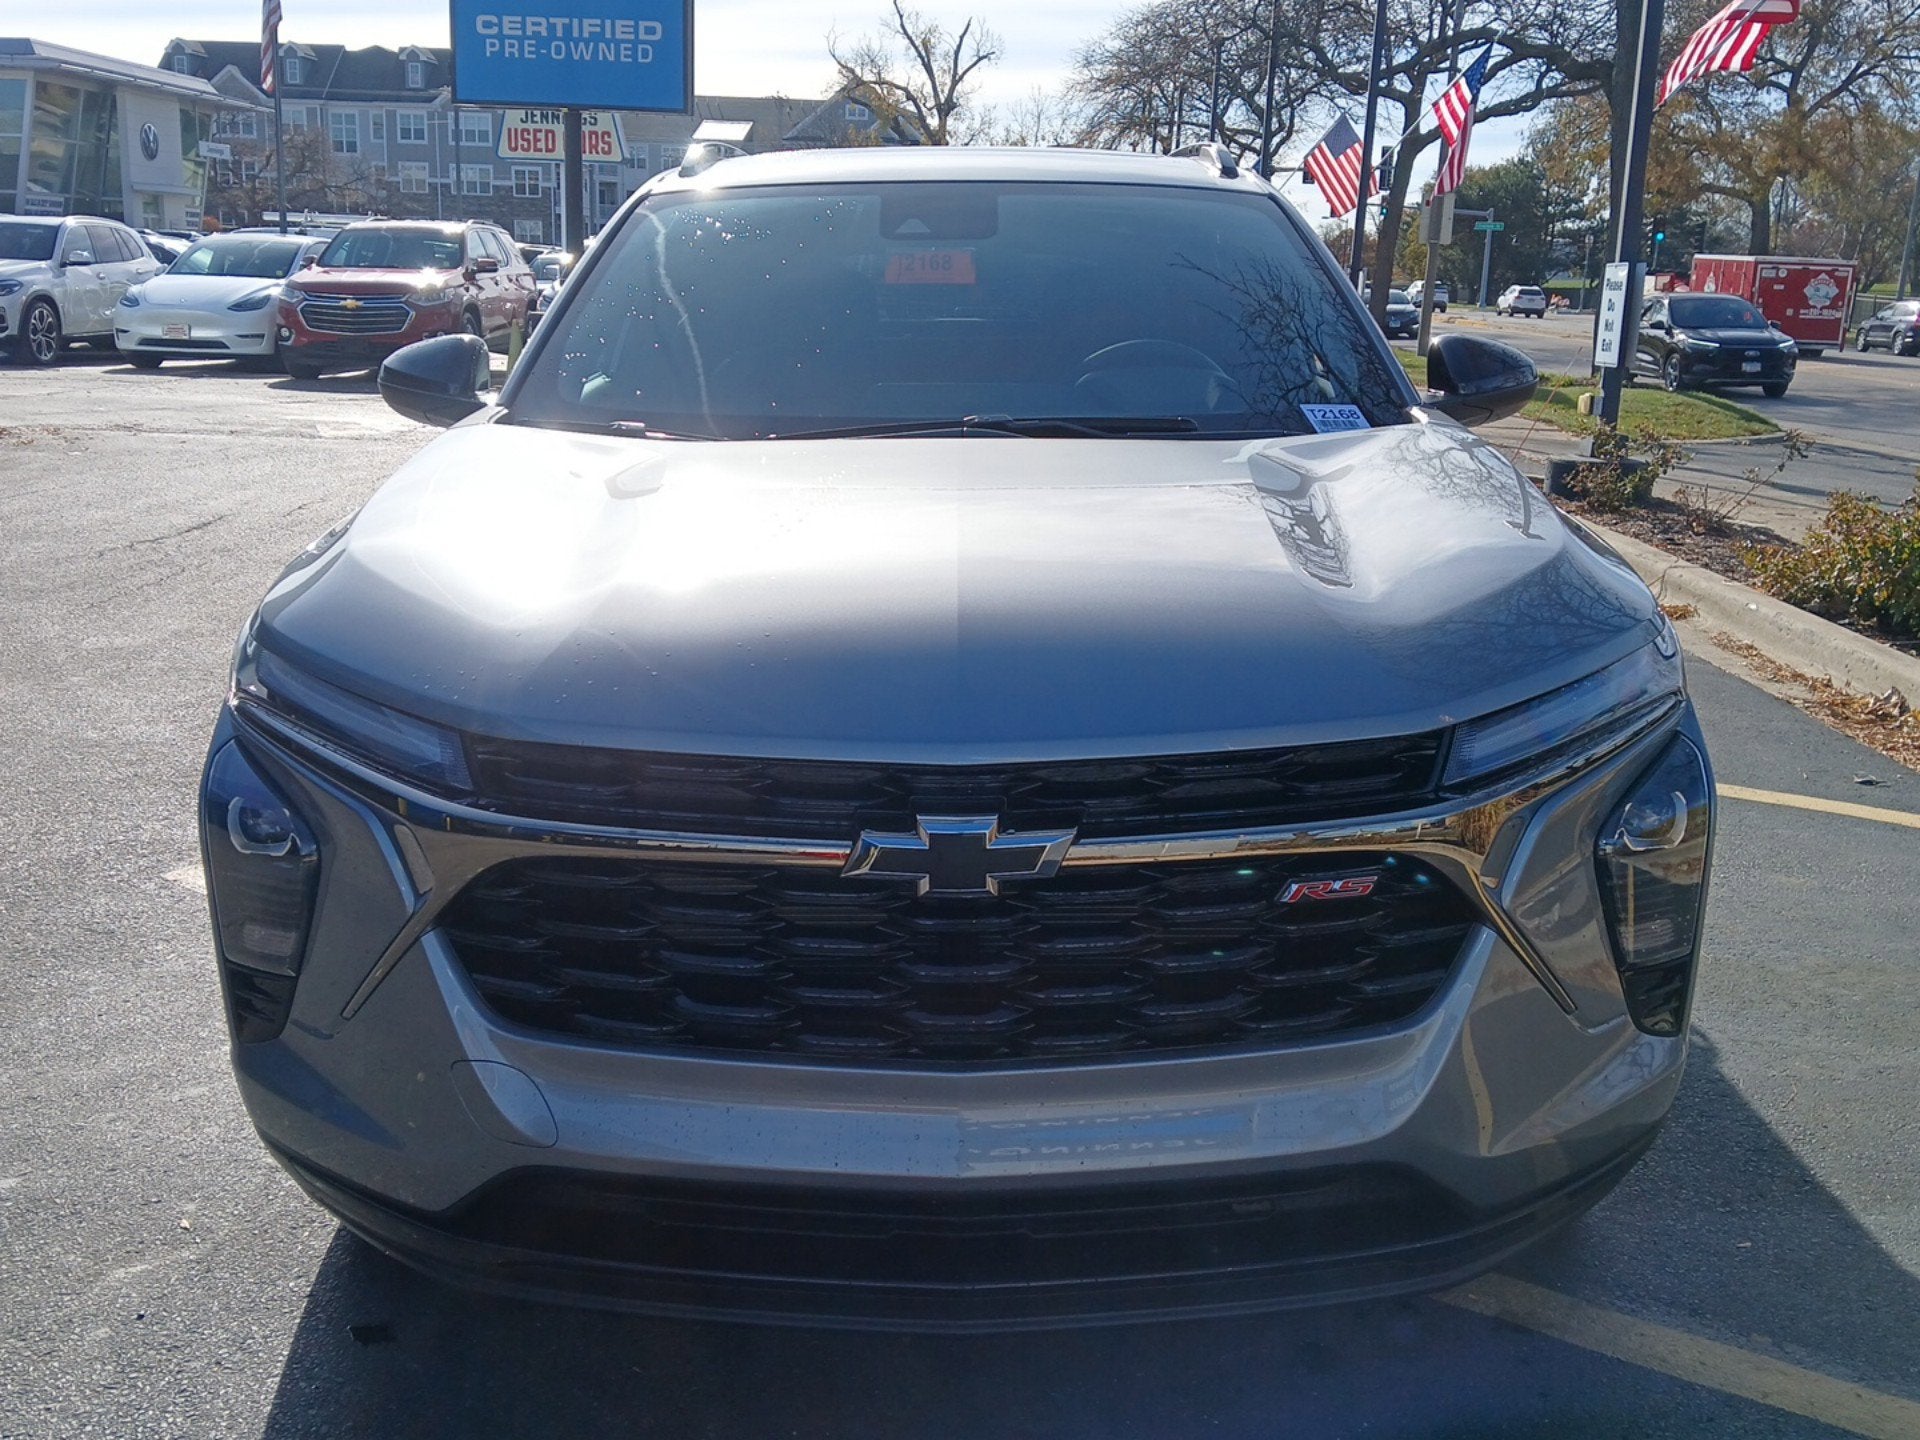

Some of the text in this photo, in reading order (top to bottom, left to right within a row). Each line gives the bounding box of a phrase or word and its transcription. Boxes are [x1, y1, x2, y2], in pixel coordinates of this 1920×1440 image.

[475, 14, 663, 41] CERTIFIED
[485, 38, 654, 63] PRE-OWNED
[507, 127, 557, 153] USED
[1605, 278, 1624, 291] Please
[1607, 298, 1615, 312] Do
[1604, 319, 1615, 332] Not
[1601, 338, 1613, 352] Exit
[1306, 408, 1361, 420] T2168
[1280, 876, 1378, 903] RS
